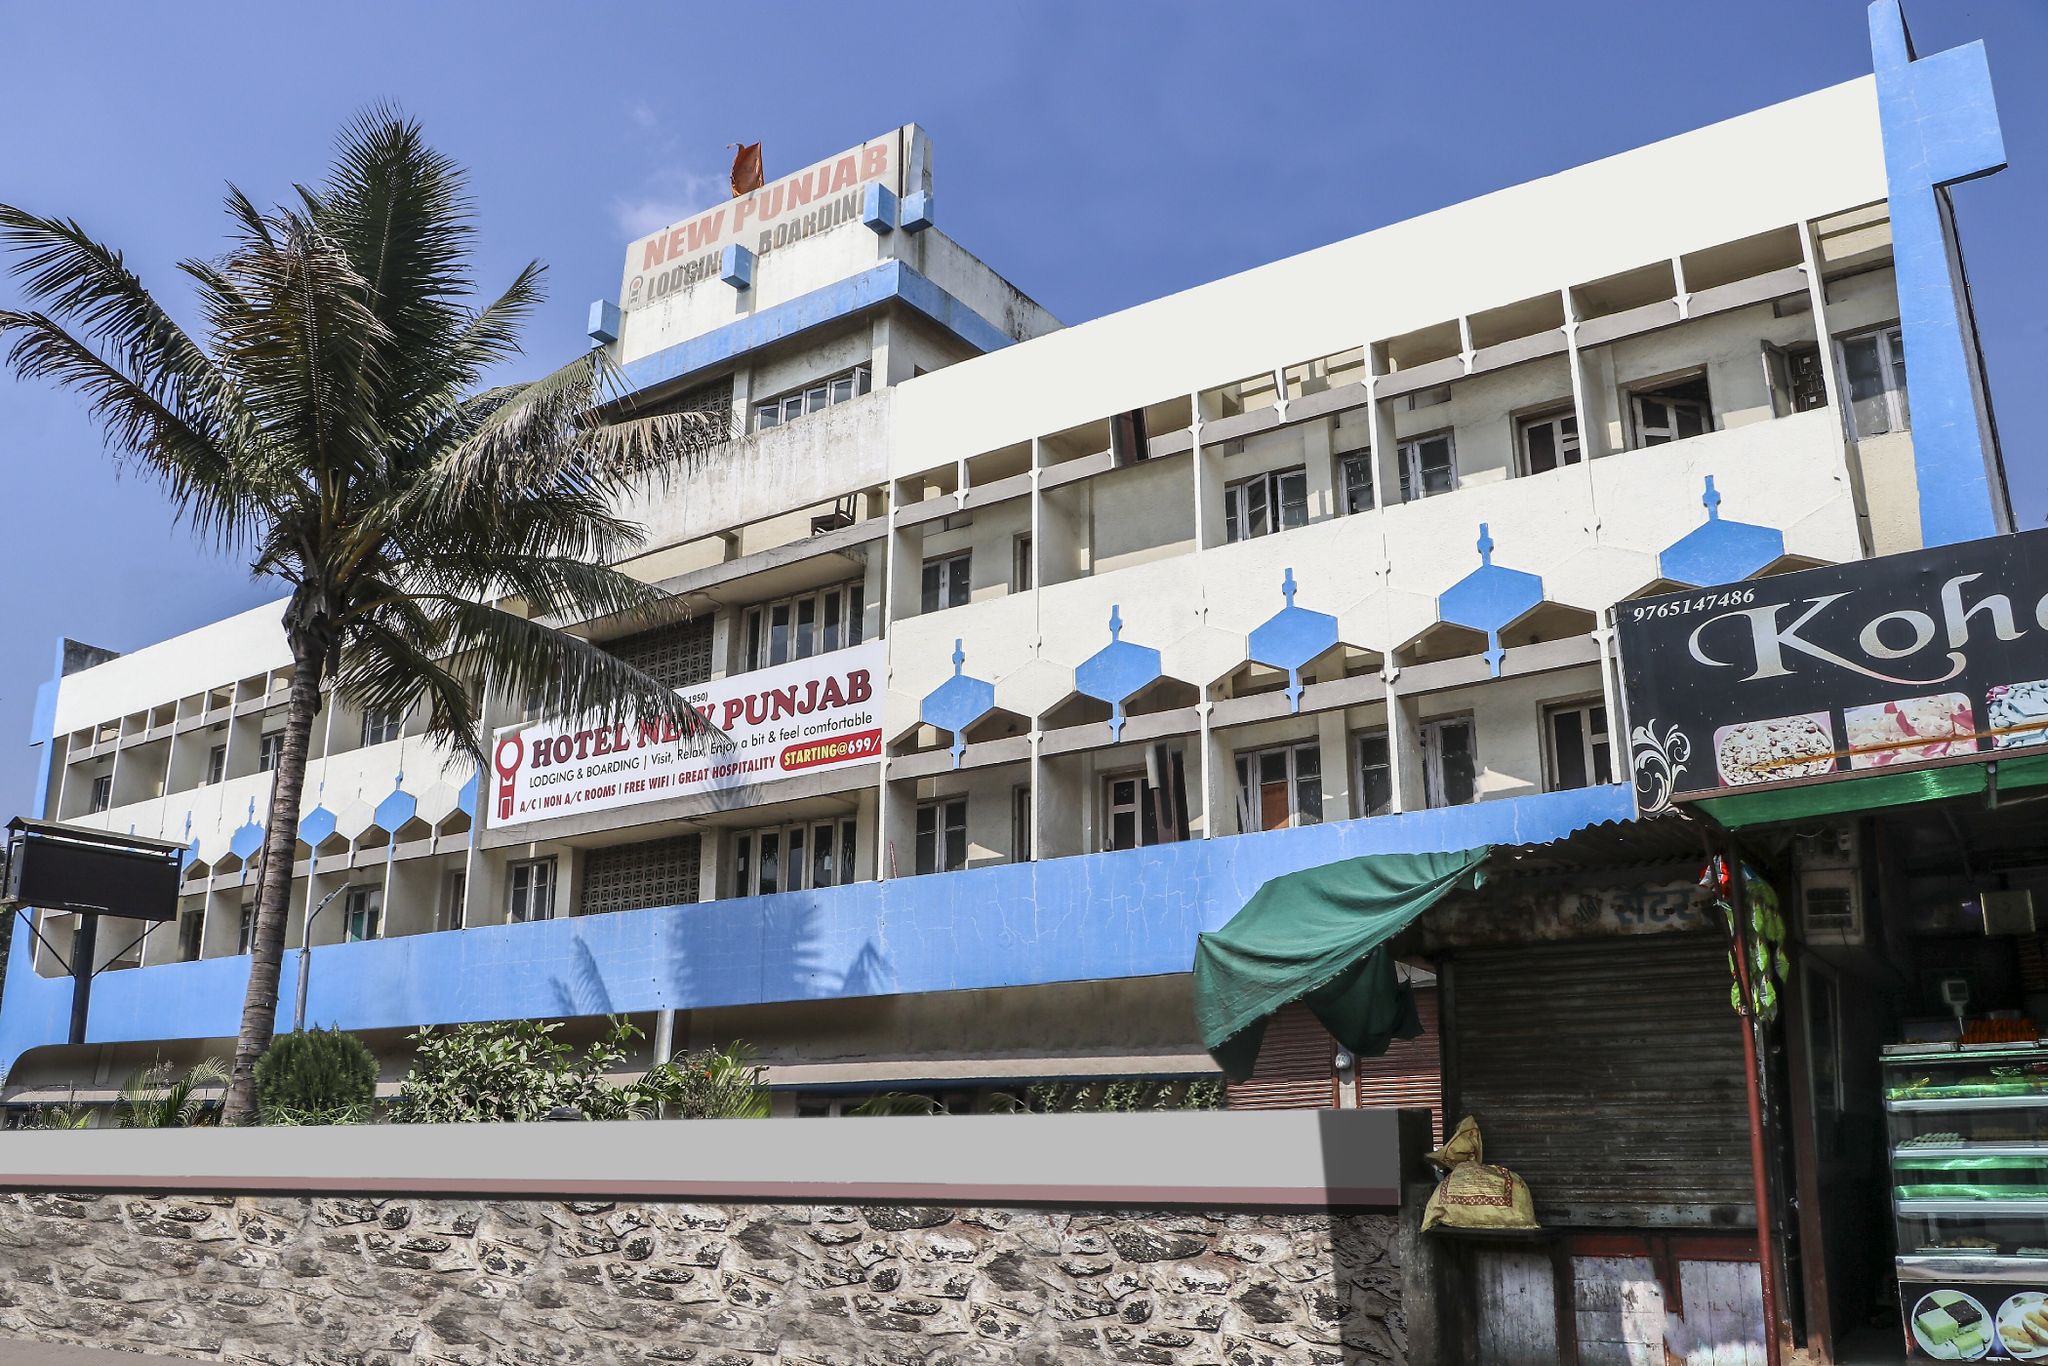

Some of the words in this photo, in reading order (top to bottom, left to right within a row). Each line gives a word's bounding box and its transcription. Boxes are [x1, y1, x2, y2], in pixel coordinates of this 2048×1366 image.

[643, 209, 726, 271] NEW
[733, 143, 888, 234] PUNJAB
[647, 249, 722, 301] LODGIN
[1633, 587, 1755, 622] 9765147486
[1688, 572, 2048, 685] Koh
[529, 770, 574, 788] LODGING
[577, 768, 584, 780] &
[587, 757, 640, 778] BOARDING
[651, 751, 674, 765] Visit,
[711, 741, 738, 755] Enjoy
[741, 740, 747, 748] a
[751, 733, 765, 747] bit
[768, 730, 776, 743] &
[779, 725, 800, 741] feel
[803, 711, 873, 737] comfortable
[531, 722, 630, 769] HOTEL
[721, 669, 872, 731] PUNJAB
[520, 798, 536, 813] A/C
[543, 795, 562, 808] NON
[564, 790, 582, 806] A/C
[585, 785, 616, 800] ROOMS
[624, 779, 645, 794] FREE
[649, 775, 669, 790] WIFI
[678, 768, 709, 785] GREAT
[712, 756, 775, 779] HOSPITALITY
